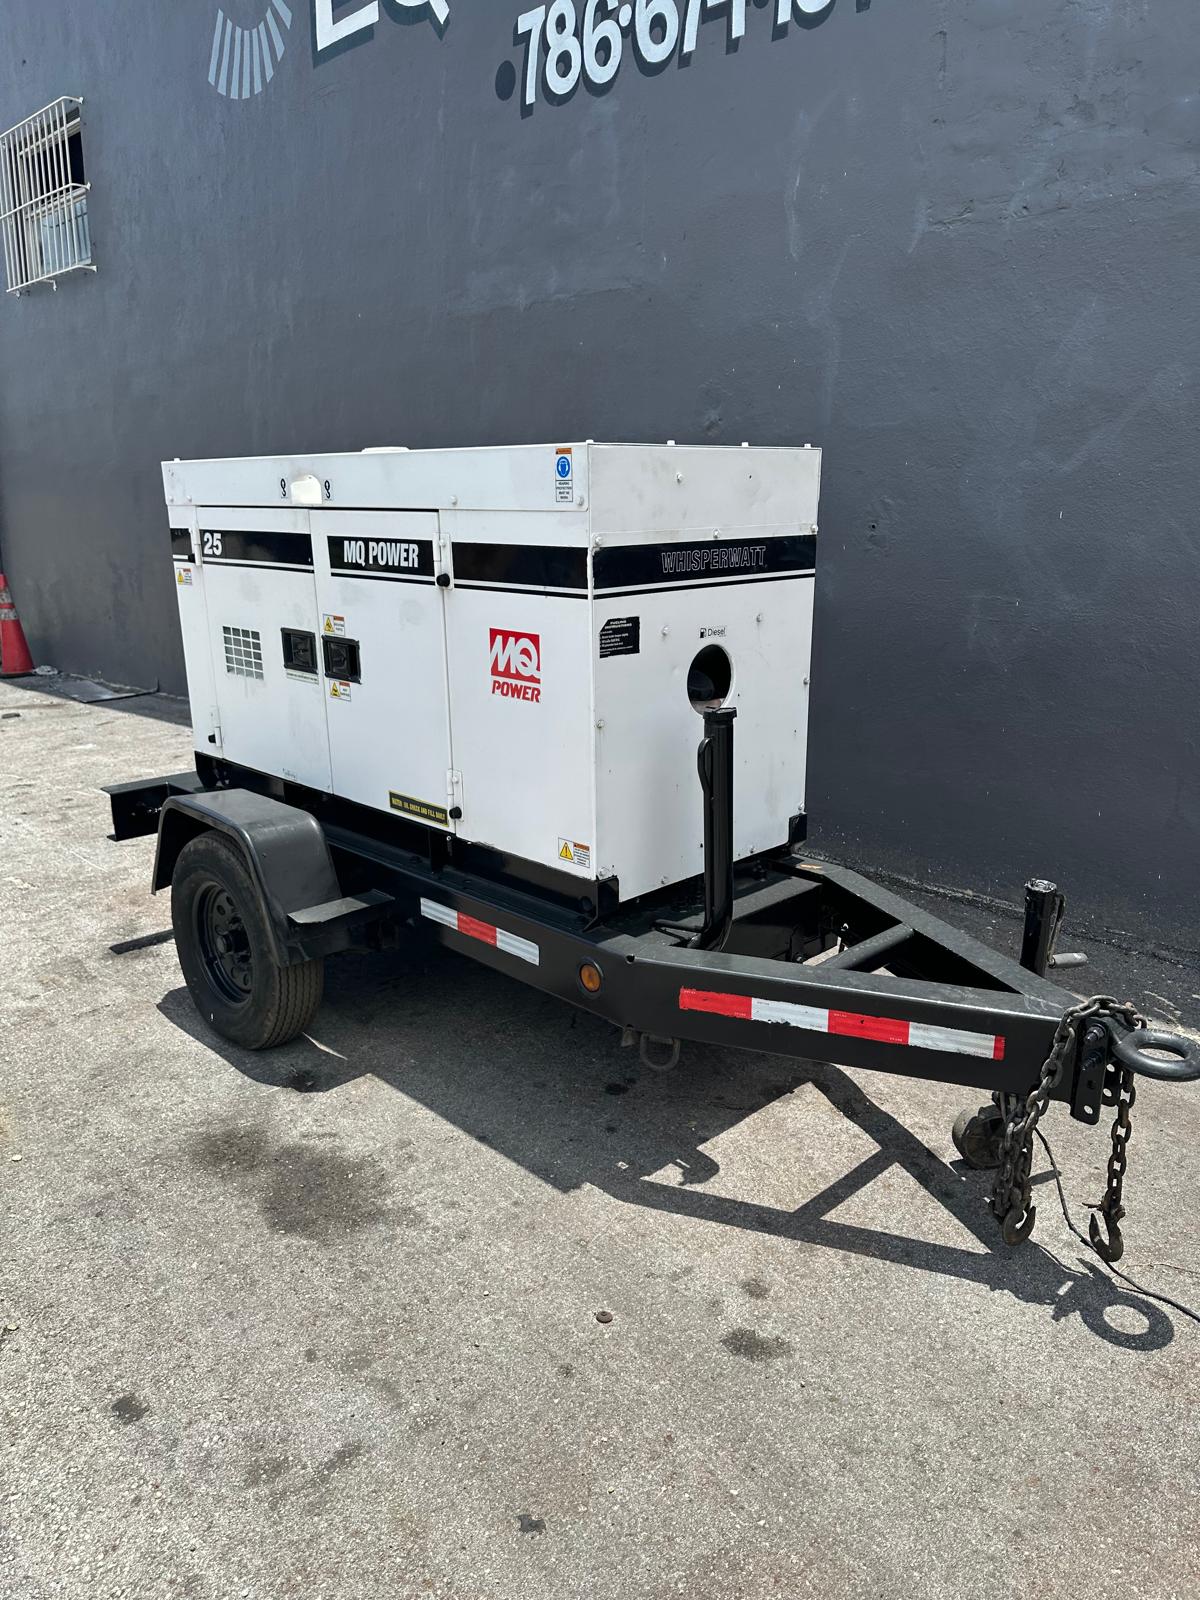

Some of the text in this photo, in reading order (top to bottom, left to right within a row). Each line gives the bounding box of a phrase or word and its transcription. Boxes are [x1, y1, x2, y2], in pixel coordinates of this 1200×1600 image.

[203, 532, 223, 556] 25
[343, 540, 419, 568] MQ POWER
[661, 546, 766, 573] WHISPERWATT
[707, 627, 726, 637] Diesel
[489, 634, 541, 679] MQ
[491, 680, 541, 703] POWER
